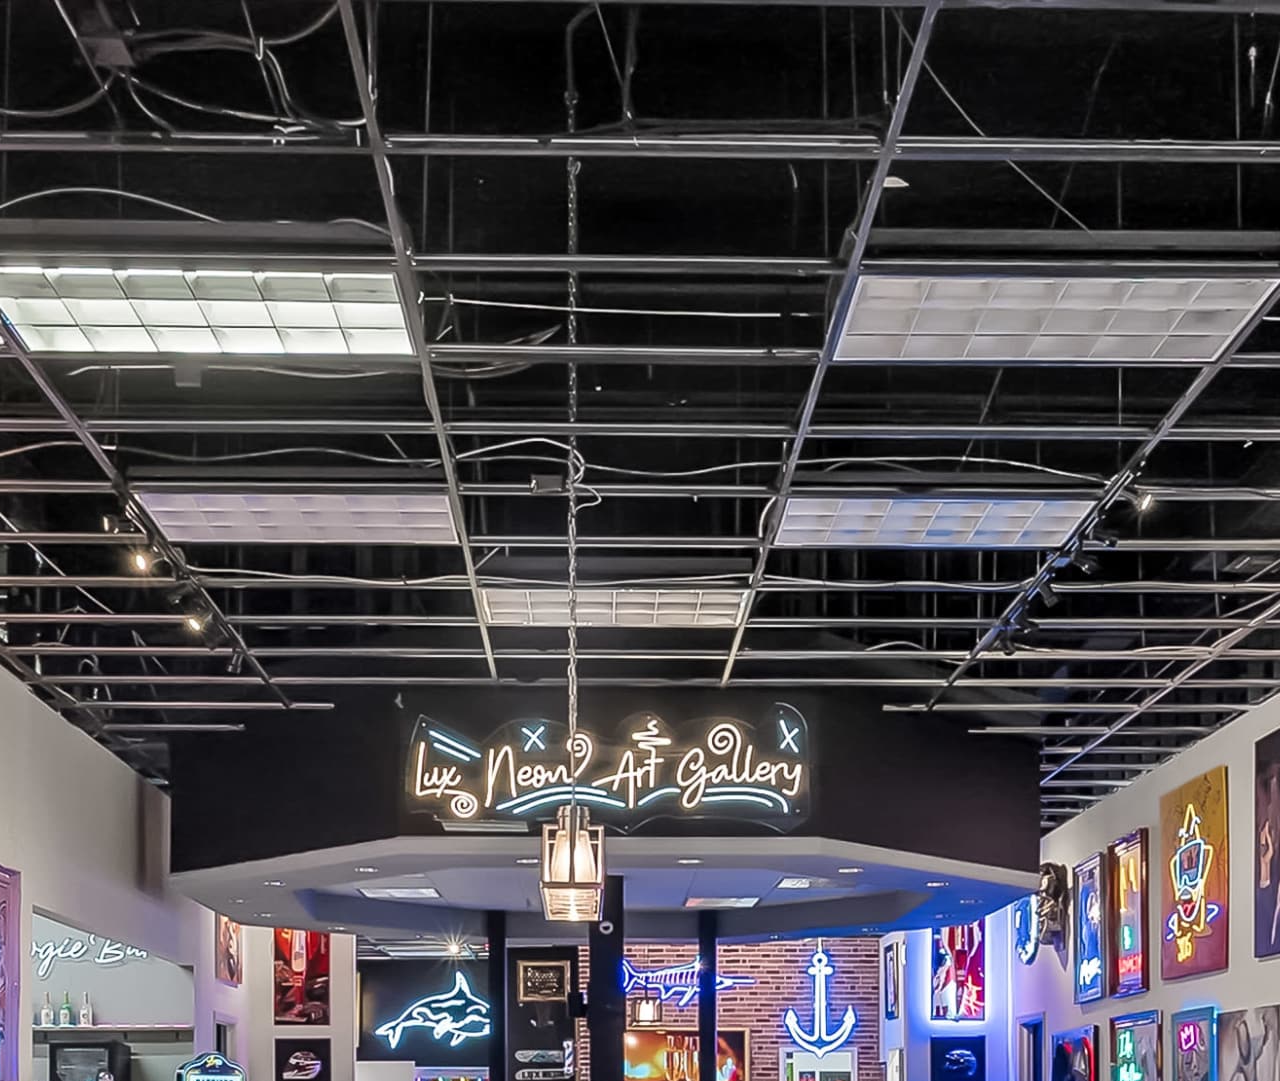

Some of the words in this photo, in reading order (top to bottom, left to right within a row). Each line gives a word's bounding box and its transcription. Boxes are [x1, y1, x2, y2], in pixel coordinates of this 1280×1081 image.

[414, 741, 478, 817] Lux
[485, 733, 593, 808] Neon
[593, 734, 666, 808] Art
[677, 723, 803, 808] Gallery
